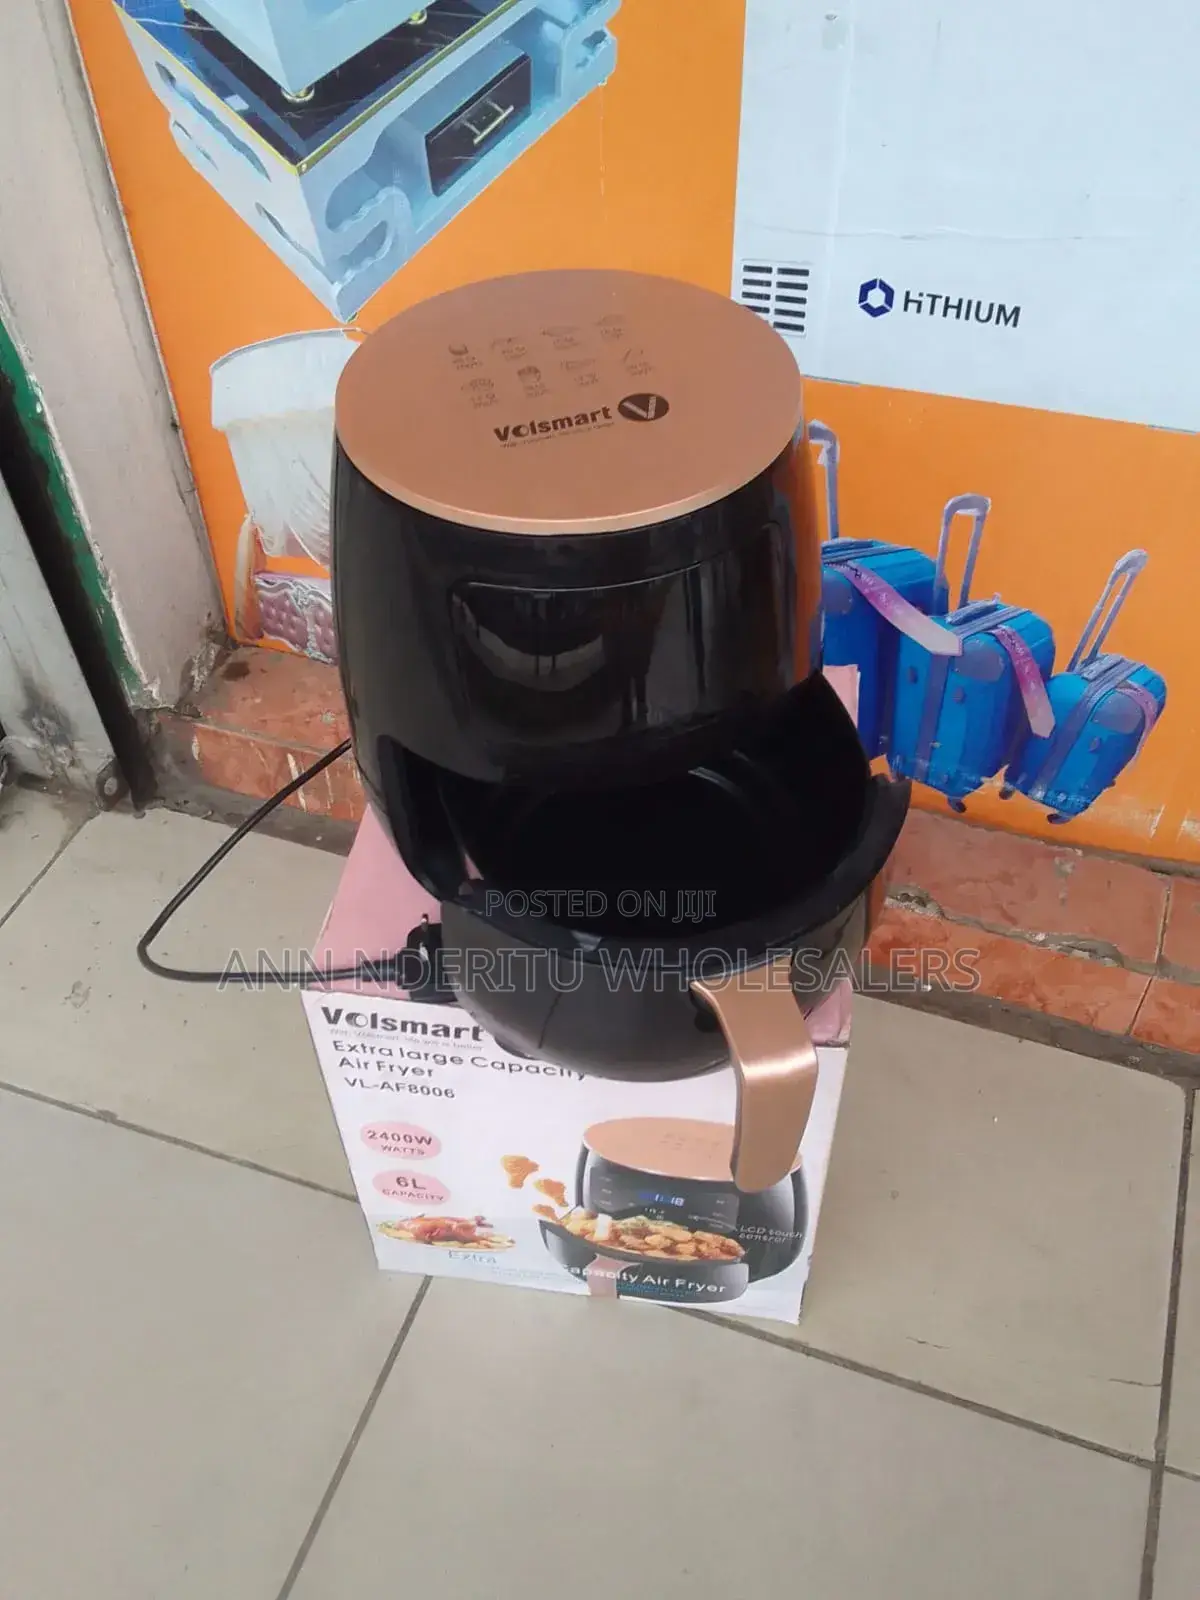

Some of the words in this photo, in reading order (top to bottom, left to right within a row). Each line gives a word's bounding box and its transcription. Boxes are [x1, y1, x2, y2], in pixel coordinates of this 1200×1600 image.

[903, 290, 1021, 328] HiTHIUM
[493, 405, 612, 441] Volsmart
[321, 1006, 484, 1042] Volsmart
[333, 1040, 394, 1057] Extra
[400, 1047, 464, 1066] large
[338, 1056, 369, 1070] Air
[375, 1060, 434, 1078] Fryer
[344, 1077, 456, 1099] VL-AF8006
[366, 1129, 433, 1146] 2400W
[380, 1144, 426, 1156] WATTS
[395, 1175, 427, 1190] 6L
[381, 1188, 445, 1202] CAPACITY
[740, 1225, 767, 1234] LCD
[642, 1275, 671, 1286] Air
[675, 1279, 727, 1294] Fryer
